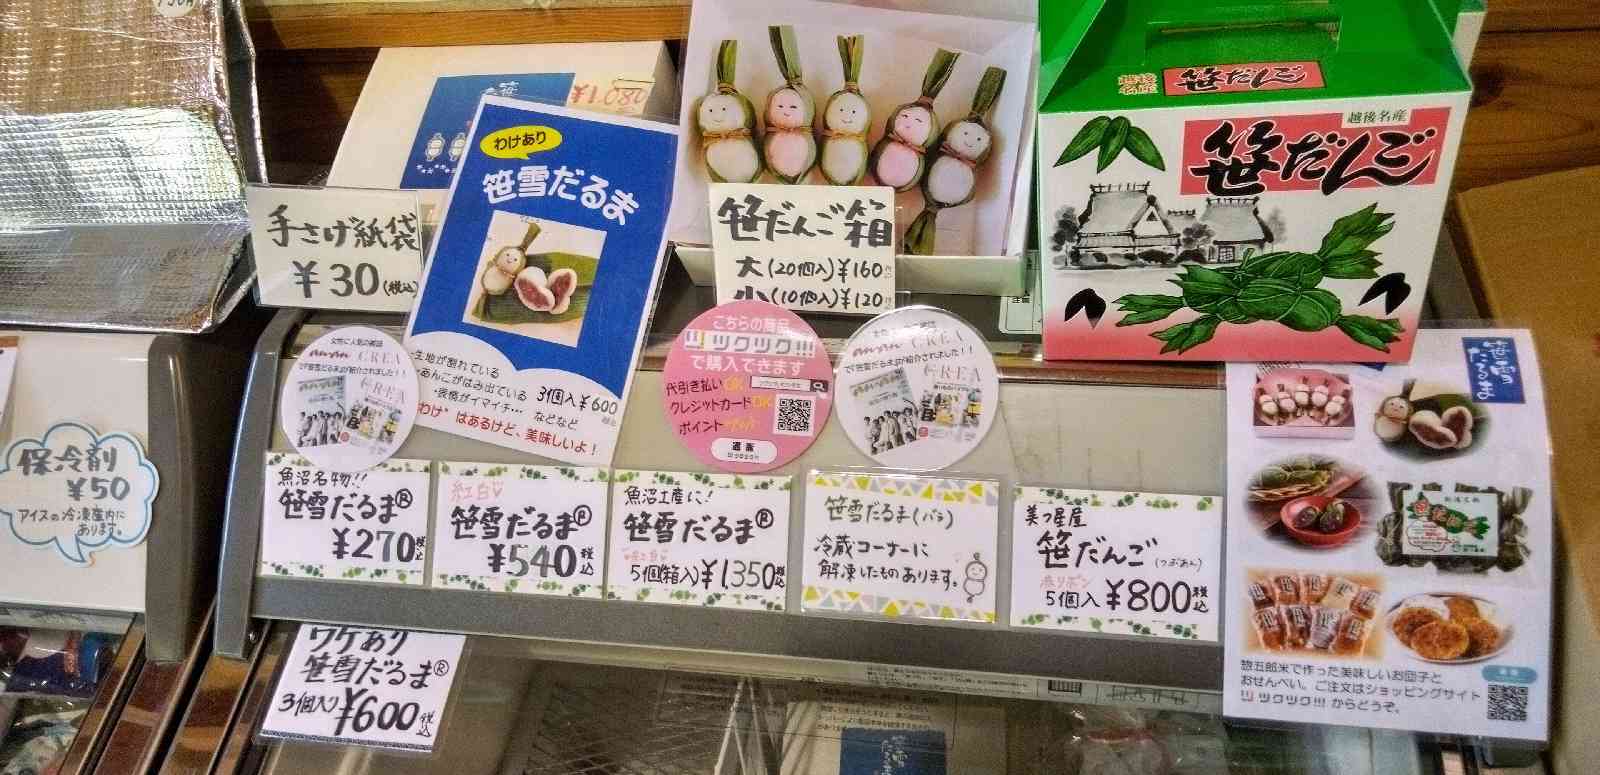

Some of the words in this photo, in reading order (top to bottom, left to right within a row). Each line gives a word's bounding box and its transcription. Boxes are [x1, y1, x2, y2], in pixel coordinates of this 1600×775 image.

[494, 131, 546, 151] わけあり
[1189, 120, 1437, 196] 笹だんご
[482, 165, 640, 226] 笹雪だるま
[266, 203, 421, 251] 手さげ紙袋
[716, 193, 893, 248] 笹だんご箱
[690, 355, 806, 375] で購入できます
[534, 411, 579, 431] などなど
[17, 443, 118, 476] 保冷剤
[66, 477, 130, 501] ¥50
[331, 527, 415, 563] ¥270
[487, 542, 578, 579] ¥540
[814, 533, 930, 559] 冷蔵コーナーに
